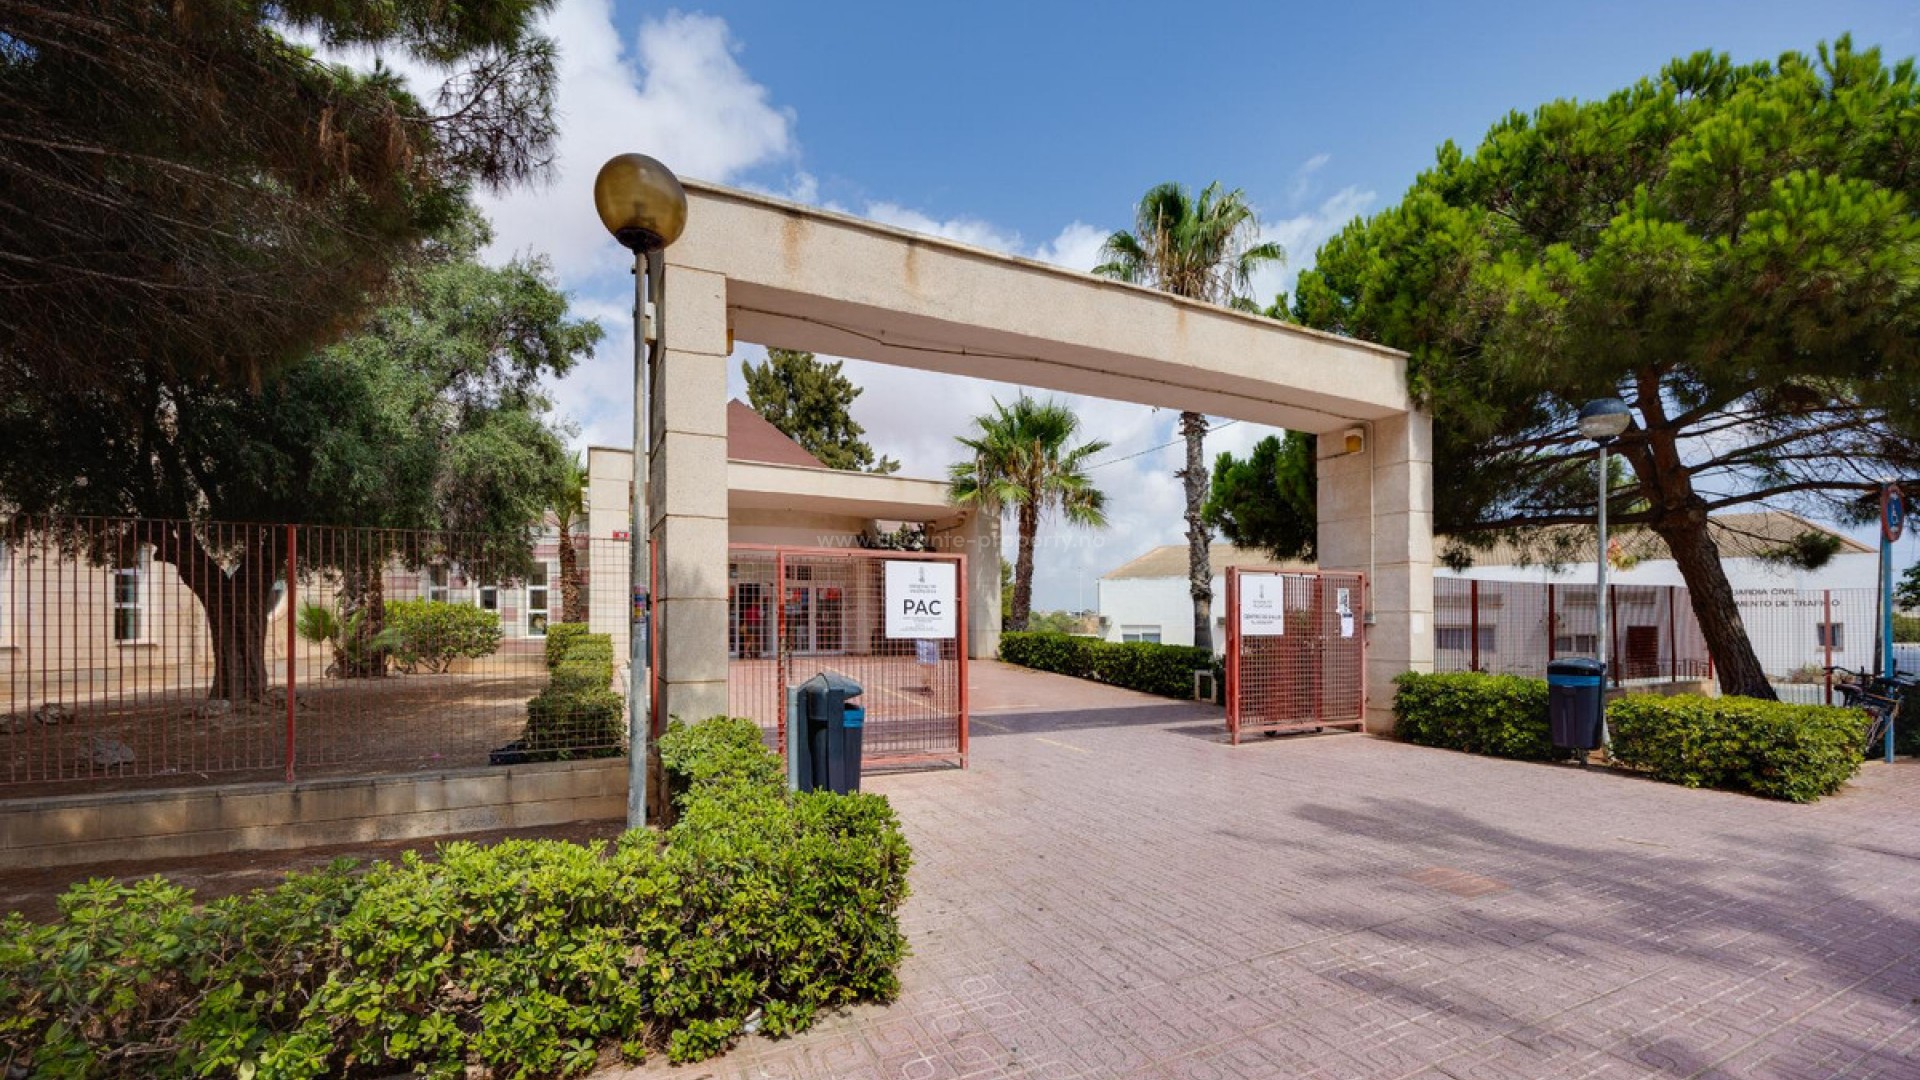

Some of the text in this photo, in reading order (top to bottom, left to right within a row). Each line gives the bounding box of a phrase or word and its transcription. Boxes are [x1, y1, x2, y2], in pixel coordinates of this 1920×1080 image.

[1770, 587, 1797, 595] CIVIL
[903, 599, 942, 616] PAC
[1735, 600, 1772, 608] MENTO
[1792, 599, 1841, 607] TRAFIO
